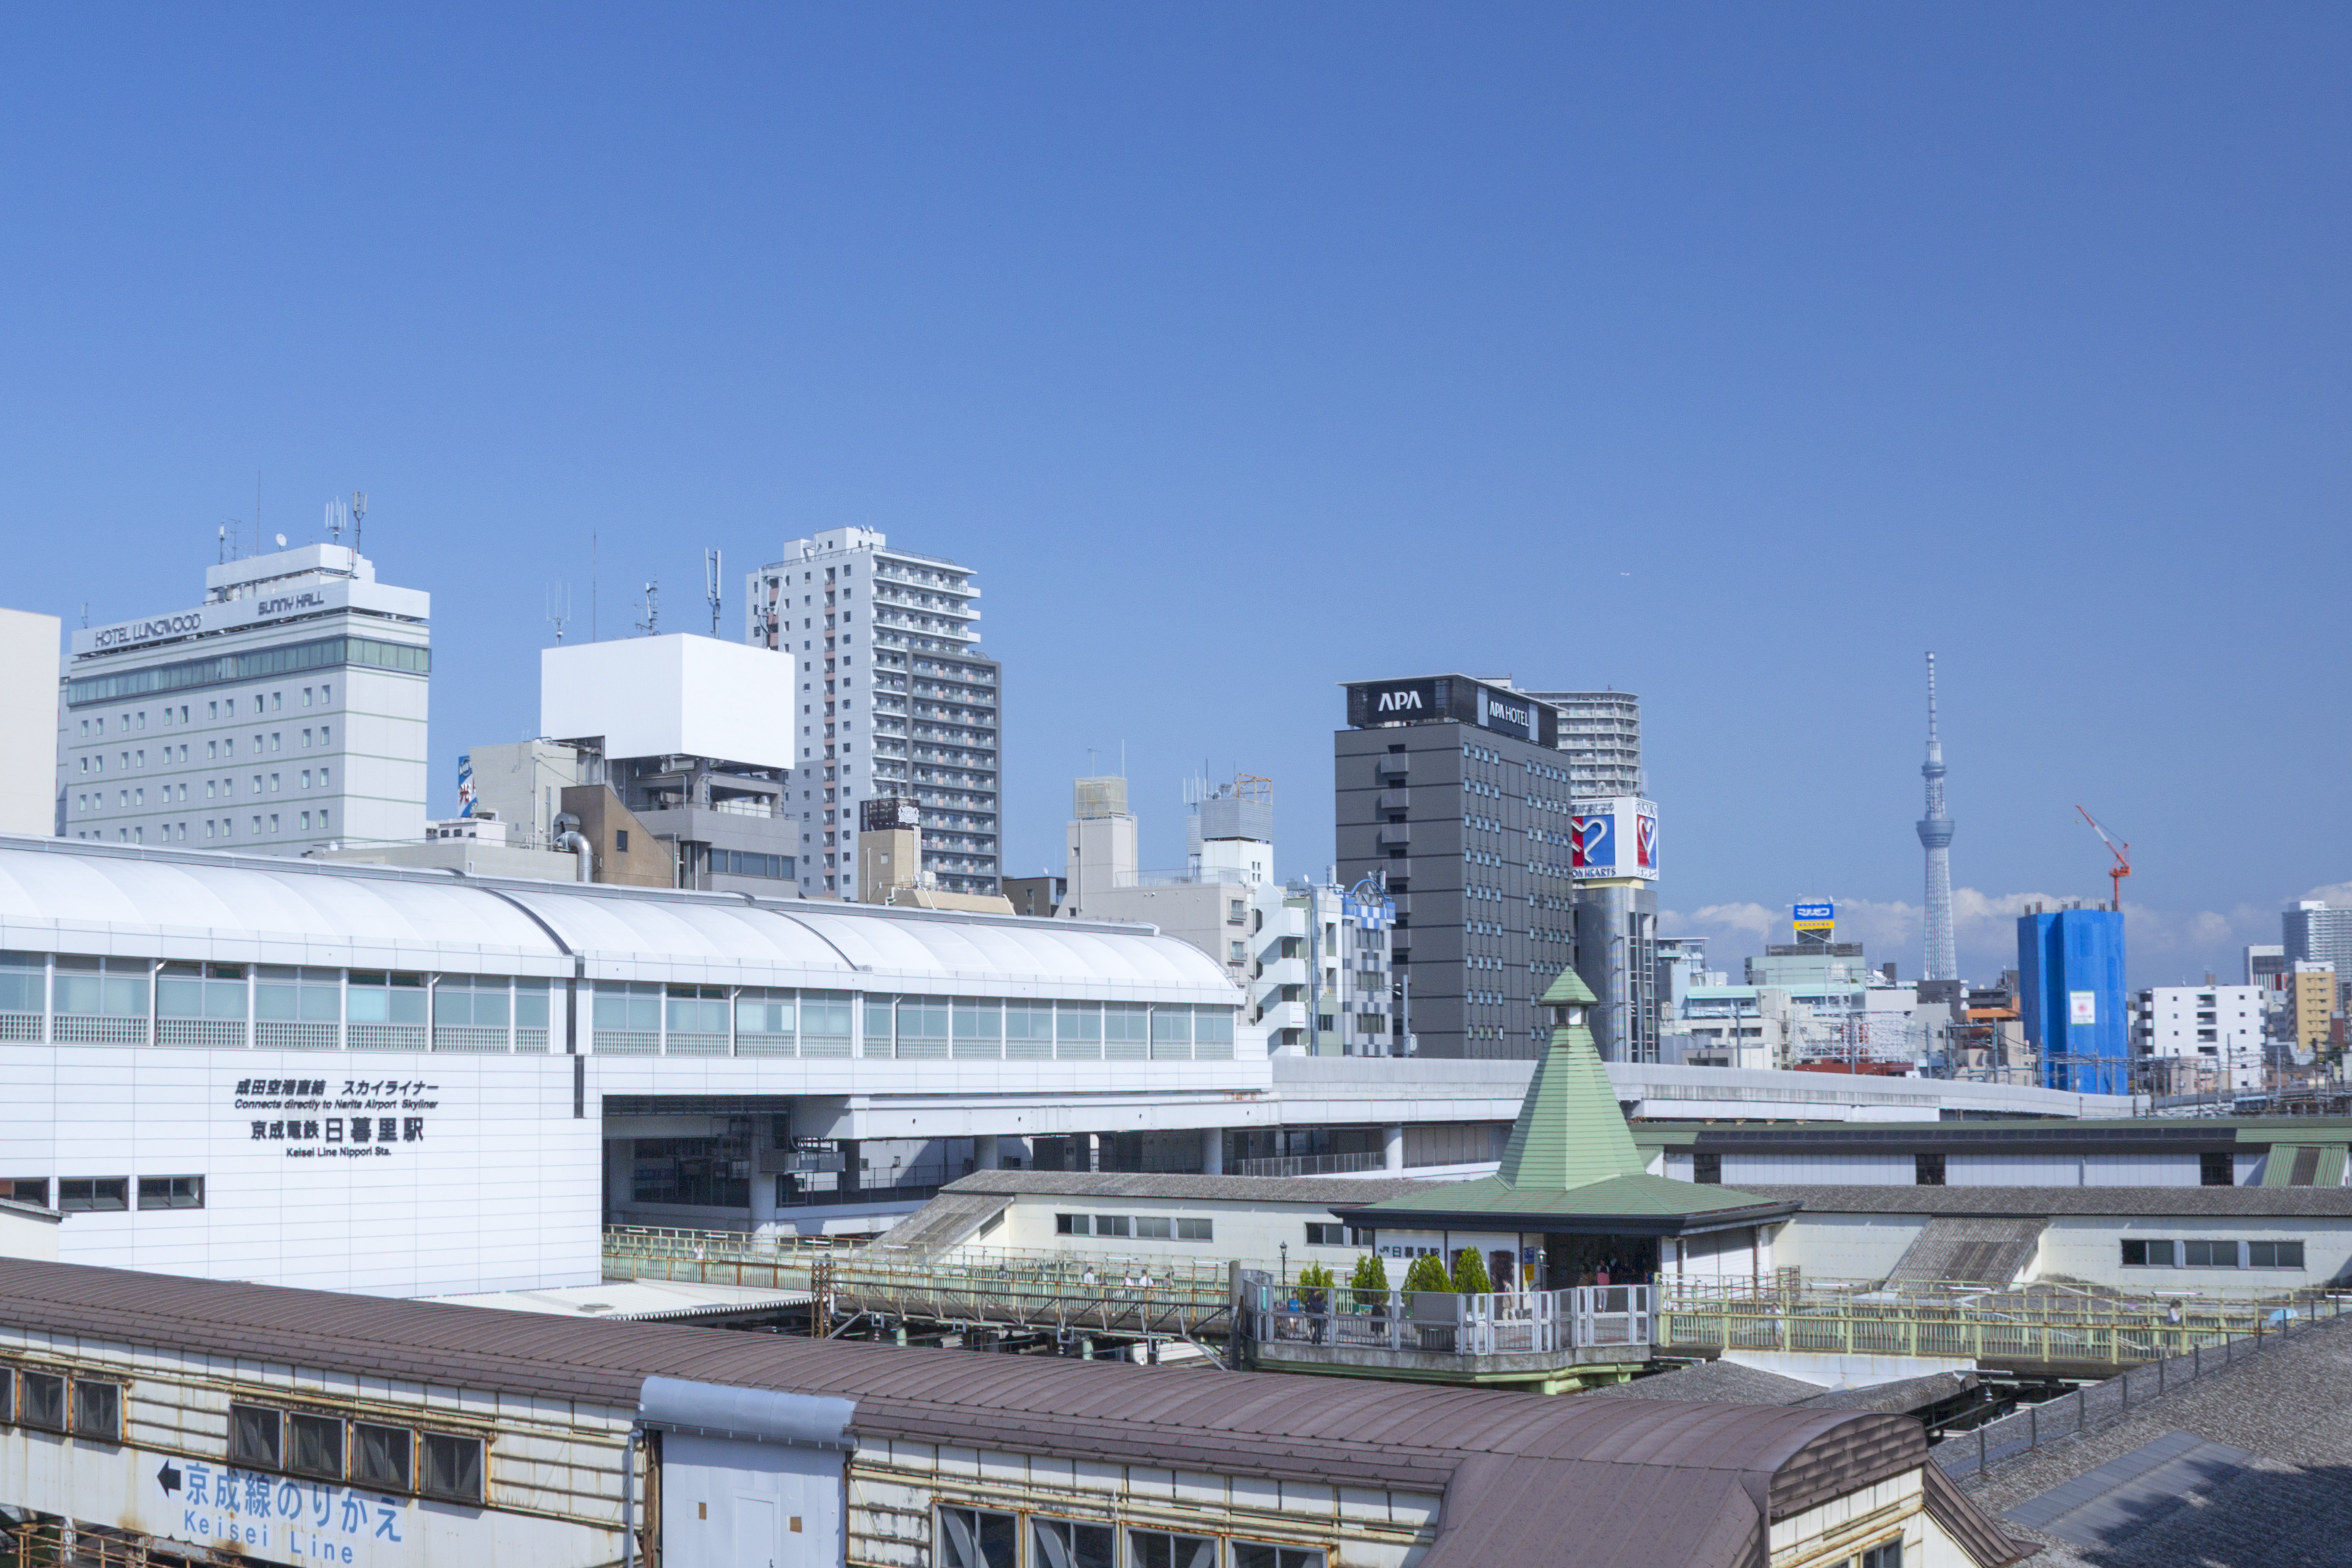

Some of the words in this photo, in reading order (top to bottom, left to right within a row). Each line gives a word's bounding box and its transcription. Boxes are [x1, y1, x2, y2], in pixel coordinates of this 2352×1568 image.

[258, 596, 293, 616] SUNNY
[296, 591, 325, 609] HALL
[95, 626, 130, 648] HOTEL
[133, 614, 201, 641] LUNGWOOD
[1378, 691, 1423, 712] APA
[1489, 701, 1505, 720] APA
[1505, 705, 1529, 727] HOTEL
[1584, 868, 1616, 877] HEARTS
[235, 1079, 326, 1095] 成田空港直結
[341, 1081, 439, 1096] スカイライナー
[235, 1099, 281, 1109] Connects
[284, 1099, 321, 1111] directly
[323, 1099, 332, 1109] to
[335, 1099, 362, 1109] Narita
[364, 1099, 397, 1111] Airport
[402, 1099, 439, 1111] Skyliner
[286, 1147, 314, 1158] Keisei
[317, 1147, 337, 1157] Line
[339, 1146, 372, 1159] Nippori
[375, 1146, 391, 1156] Sta.
[185, 1462, 402, 1543] 京成線のりかえ
[184, 1509, 268, 1547] Keisei
[290, 1530, 354, 1564] Line
